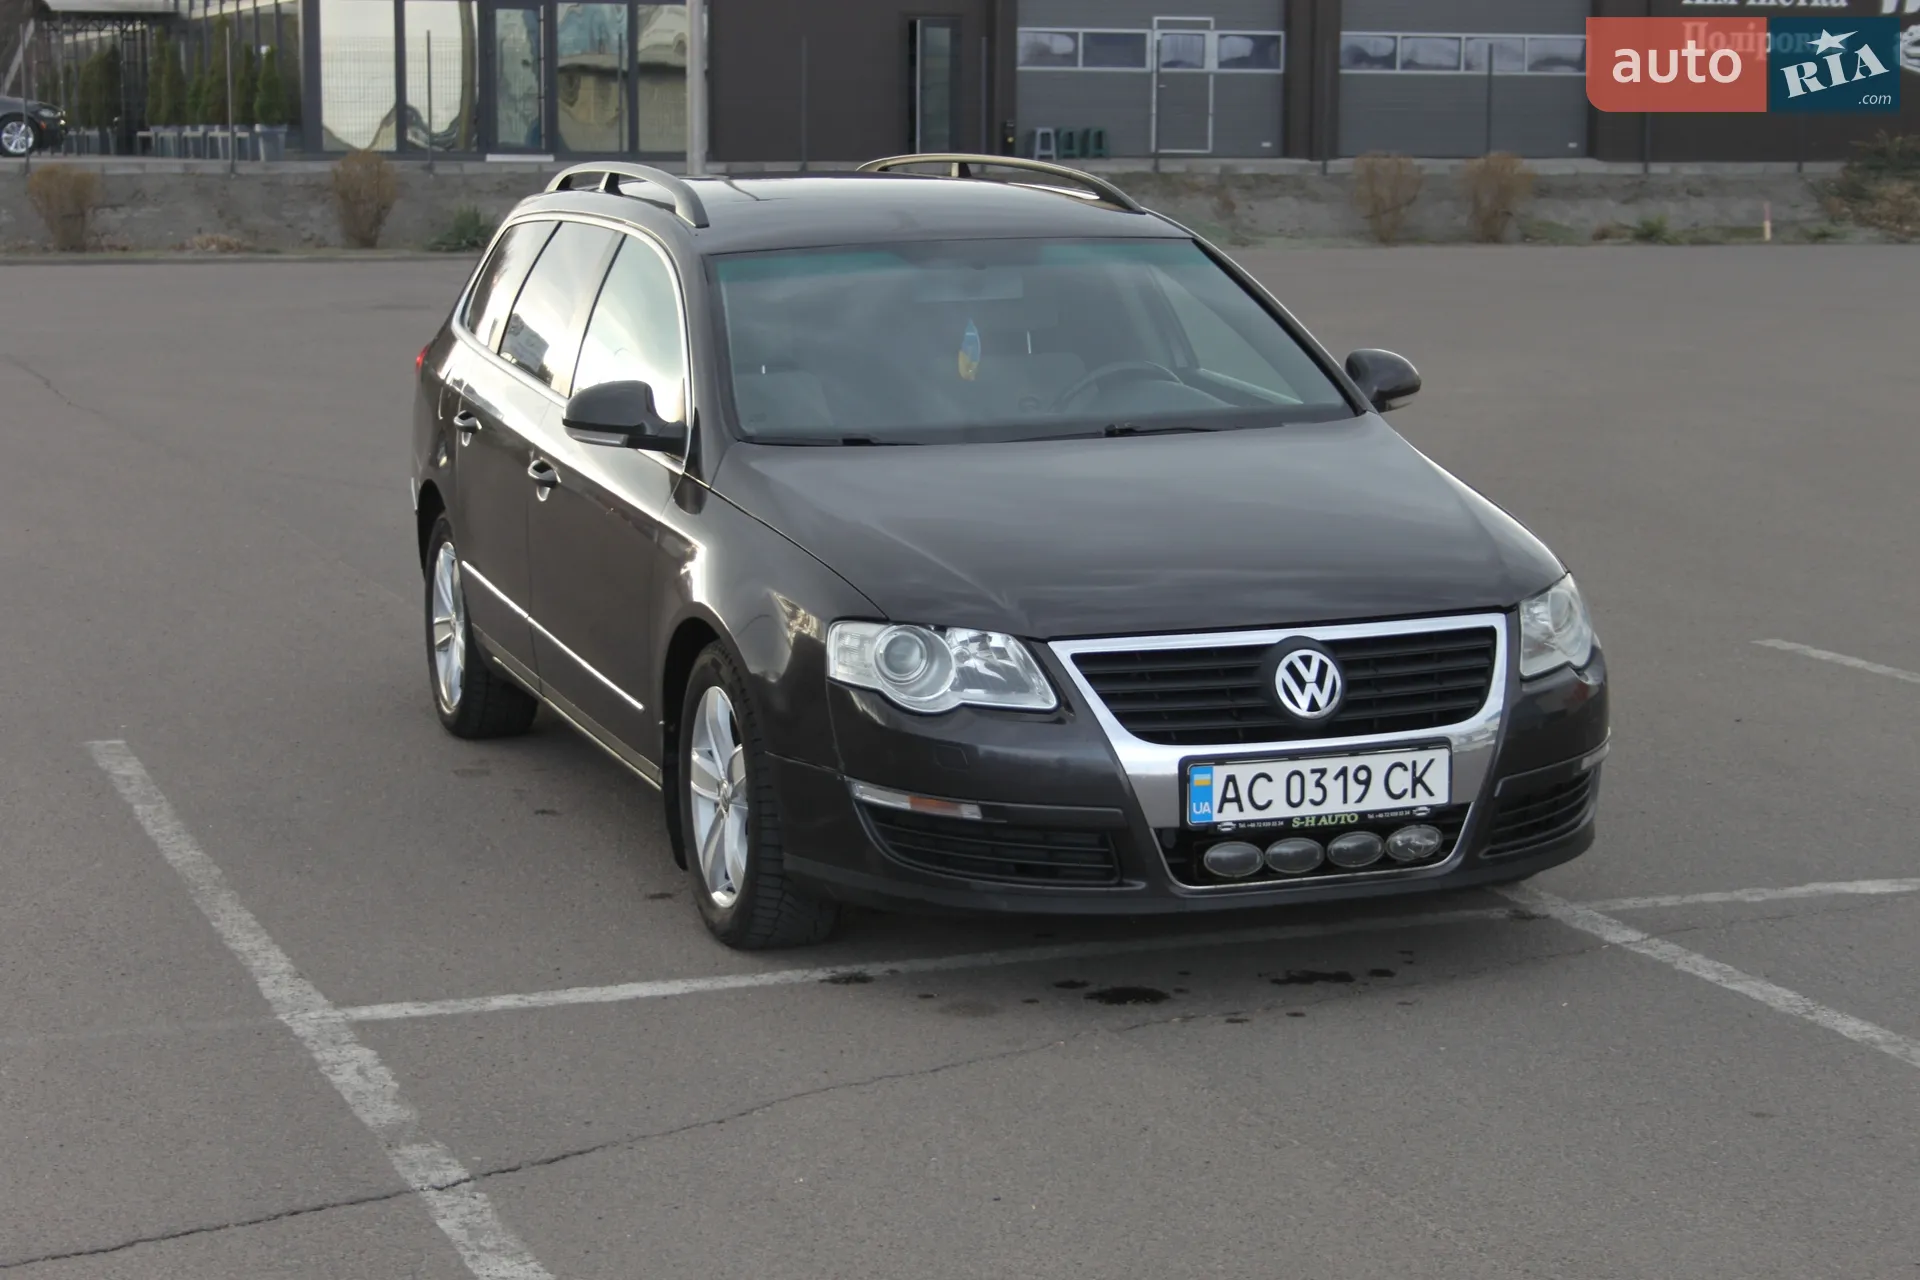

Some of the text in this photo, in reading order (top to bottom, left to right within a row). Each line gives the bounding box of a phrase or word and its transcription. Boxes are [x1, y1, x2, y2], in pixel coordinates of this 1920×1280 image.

[1682, 21, 1847, 61] Поліров
[1217, 758, 1435, 814] AC 0319 CK
[1193, 802, 1211, 814] UA
[1292, 813, 1359, 828] S-H AUTO
